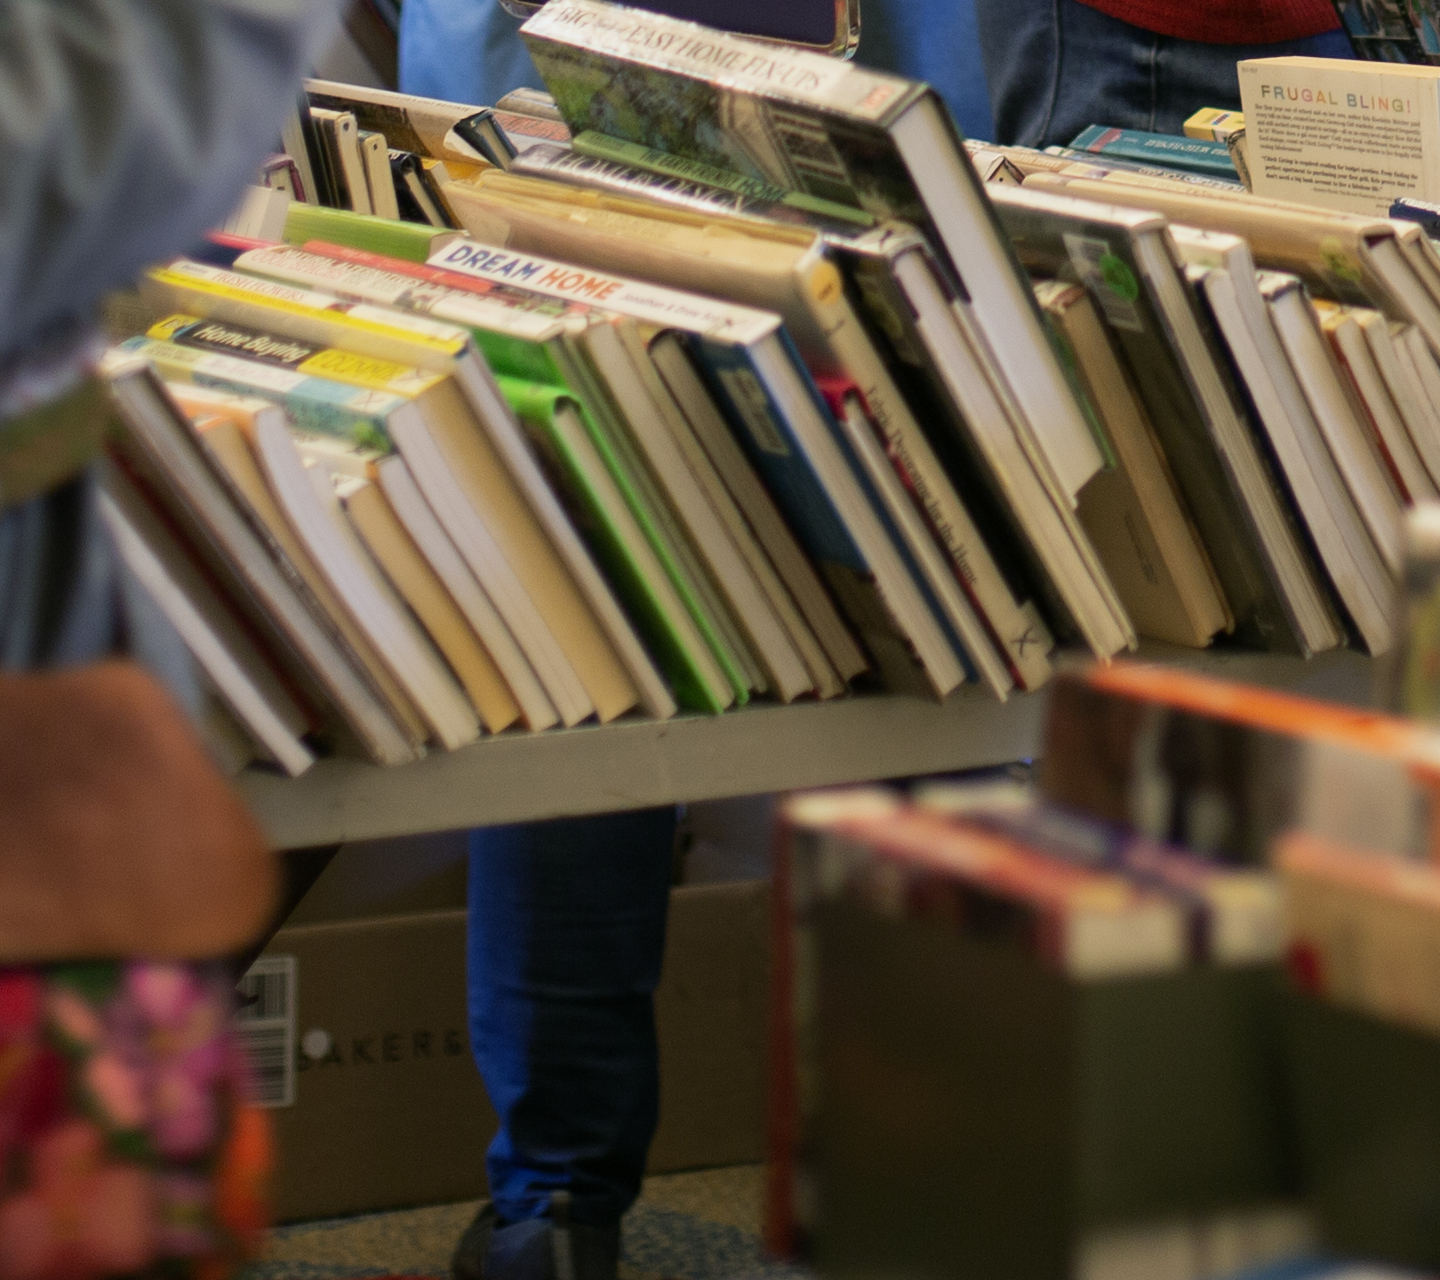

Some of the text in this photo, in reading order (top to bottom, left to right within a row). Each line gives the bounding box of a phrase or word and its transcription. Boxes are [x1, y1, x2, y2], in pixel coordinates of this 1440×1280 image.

[555, 6, 828, 89] BIG EASY HOME FIX-UPS
[1261, 85, 1411, 114] FRUGAL BLING!
[556, 151, 633, 184] HOME
[445, 244, 546, 282] DREAM
[536, 266, 624, 302] HOME
[193, 324, 311, 364] Home Buying
[953, 542, 980, 588] Home
